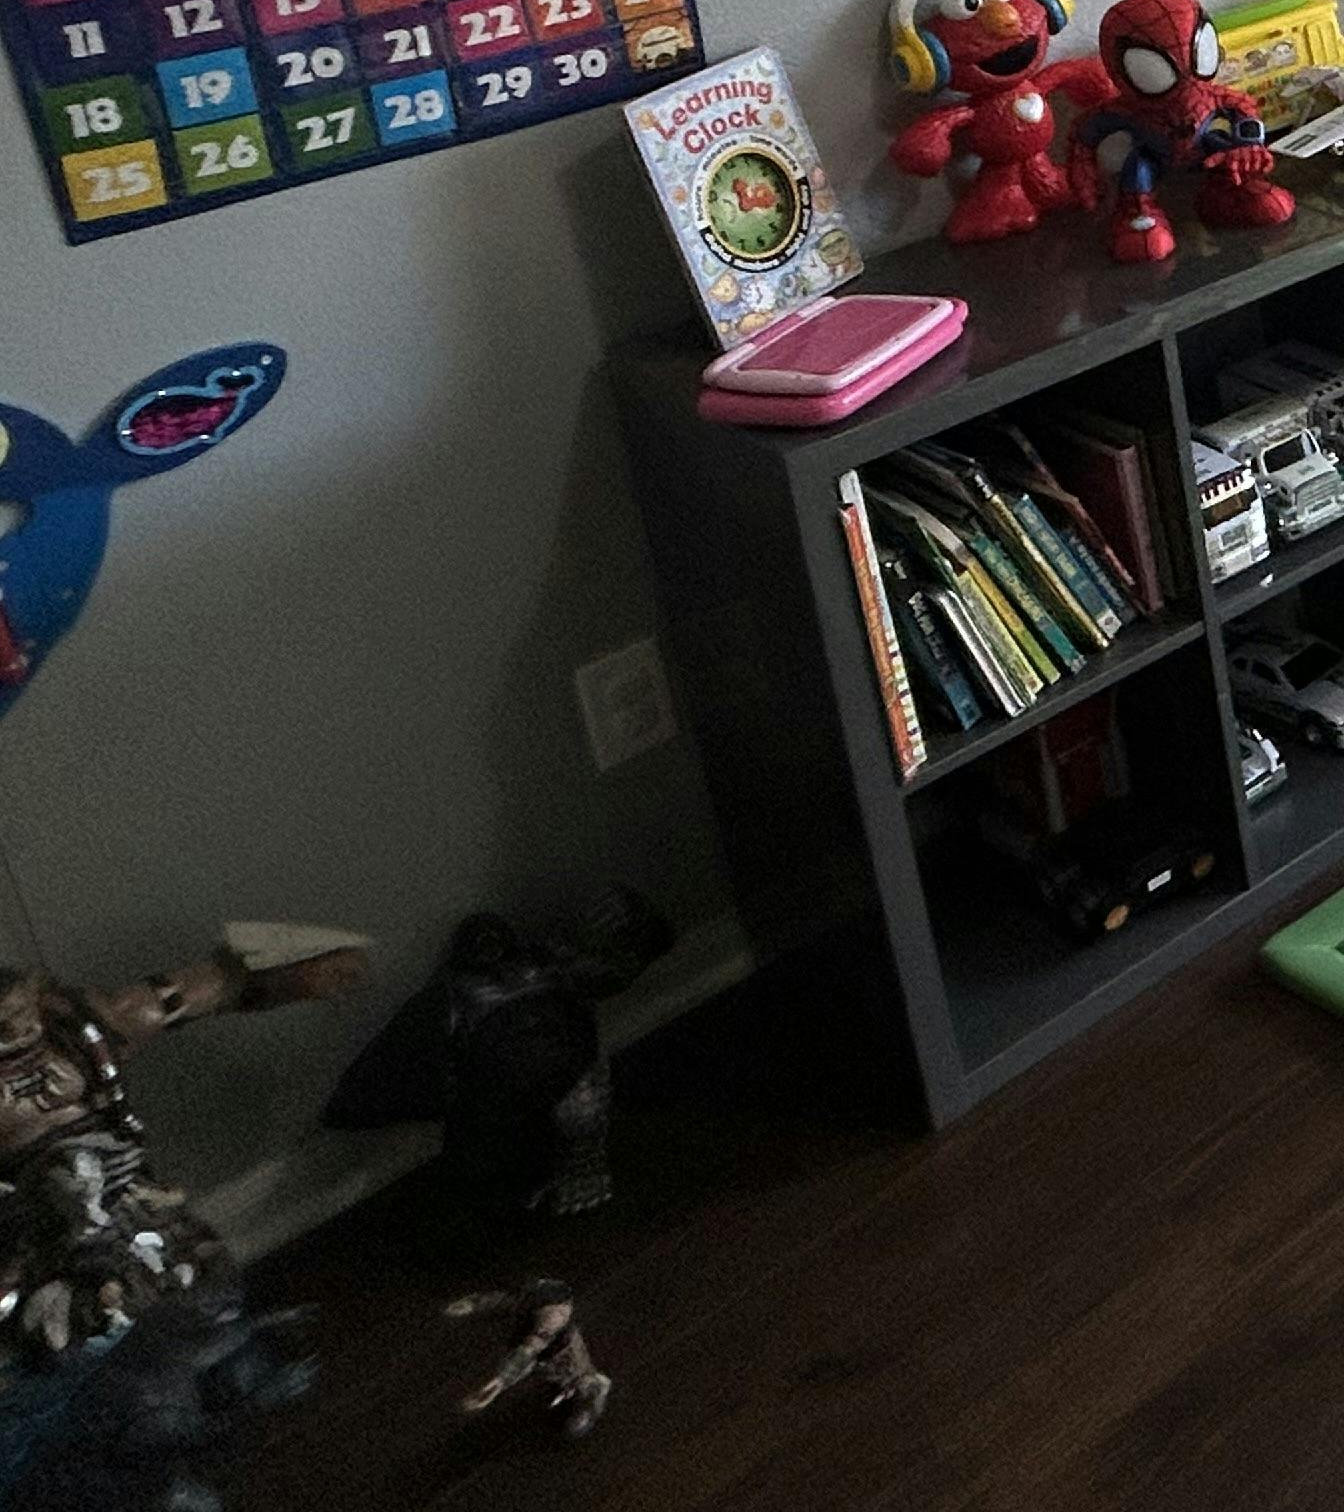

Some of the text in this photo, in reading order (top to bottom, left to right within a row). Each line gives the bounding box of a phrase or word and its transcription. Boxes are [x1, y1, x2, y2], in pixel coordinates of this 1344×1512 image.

[63, 20, 106, 59] 11
[64, 96, 124, 139] 18
[179, 69, 234, 110] 19
[276, 46, 345, 89] 20
[384, 25, 433, 64] 21
[459, 4, 522, 46] 22
[82, 48, 609, 203] 25 26 27 28 29 30
[653, 79, 773, 141] Learning
[682, 104, 763, 154] Clock
